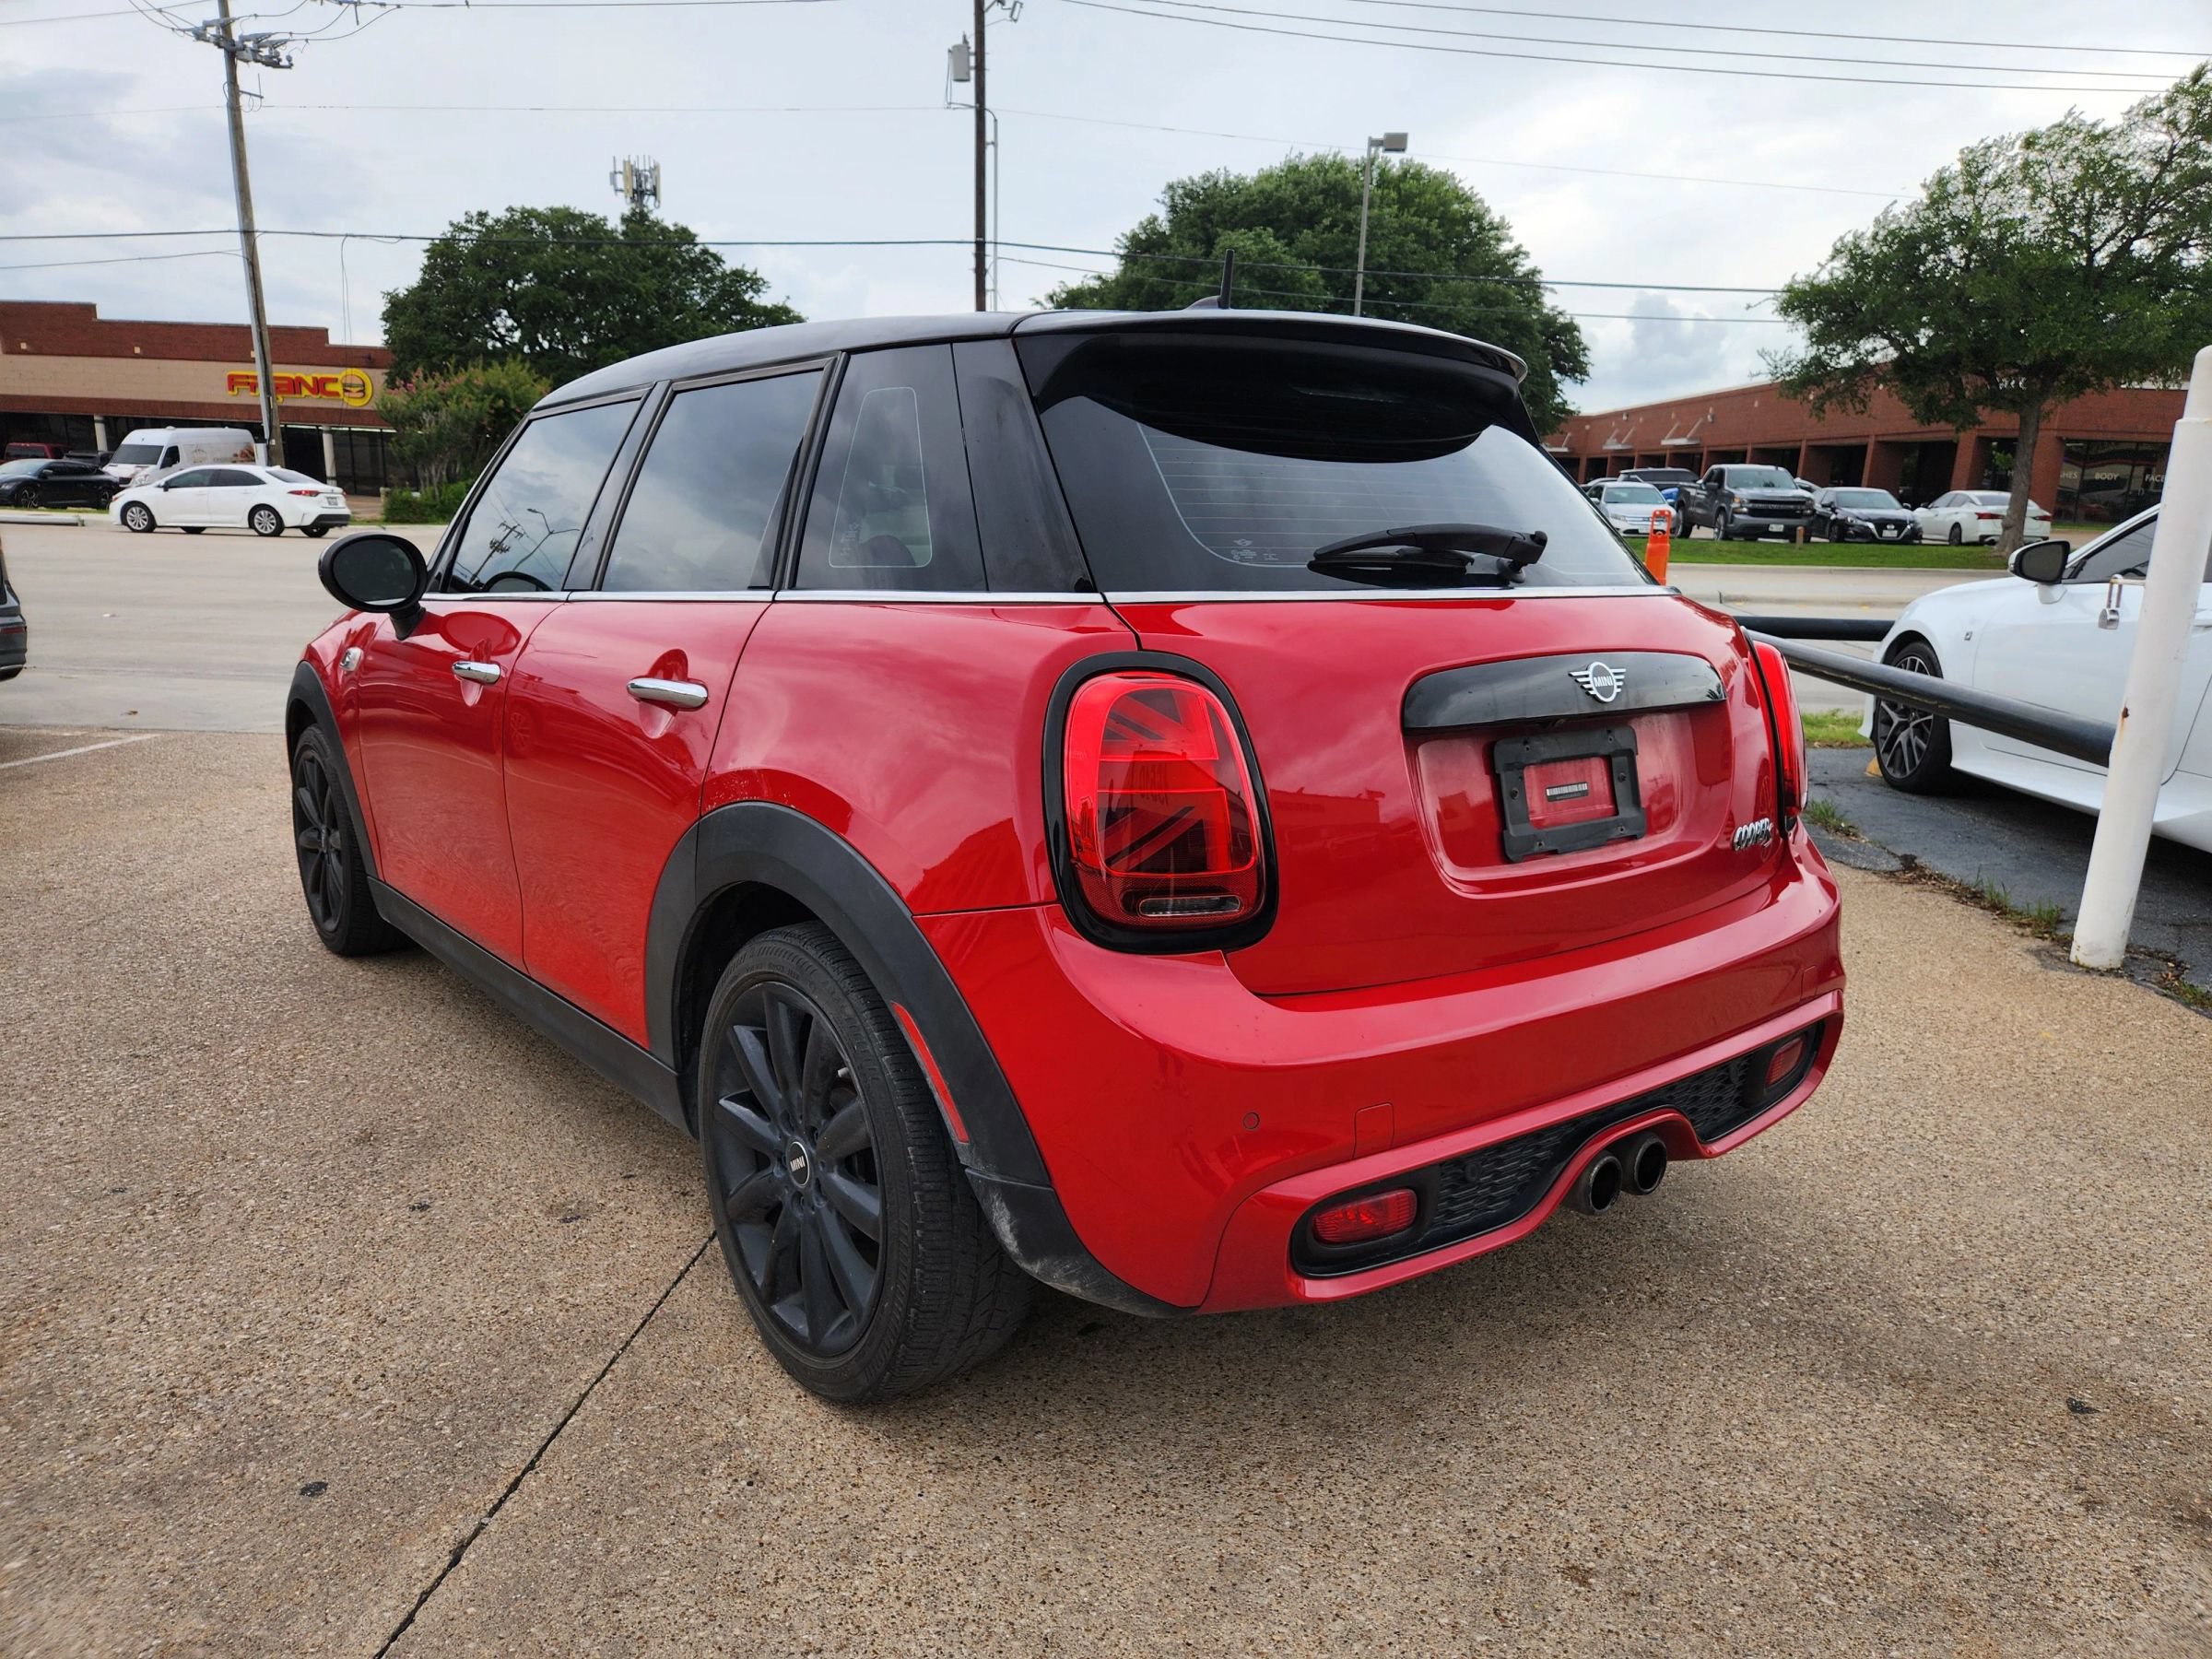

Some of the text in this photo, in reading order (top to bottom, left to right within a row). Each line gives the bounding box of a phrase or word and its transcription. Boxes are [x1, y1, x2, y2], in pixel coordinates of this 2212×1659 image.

[2094, 472, 2119, 481] BODY
[1594, 676, 1614, 687] MINI
[790, 1156, 806, 1172] MINI
